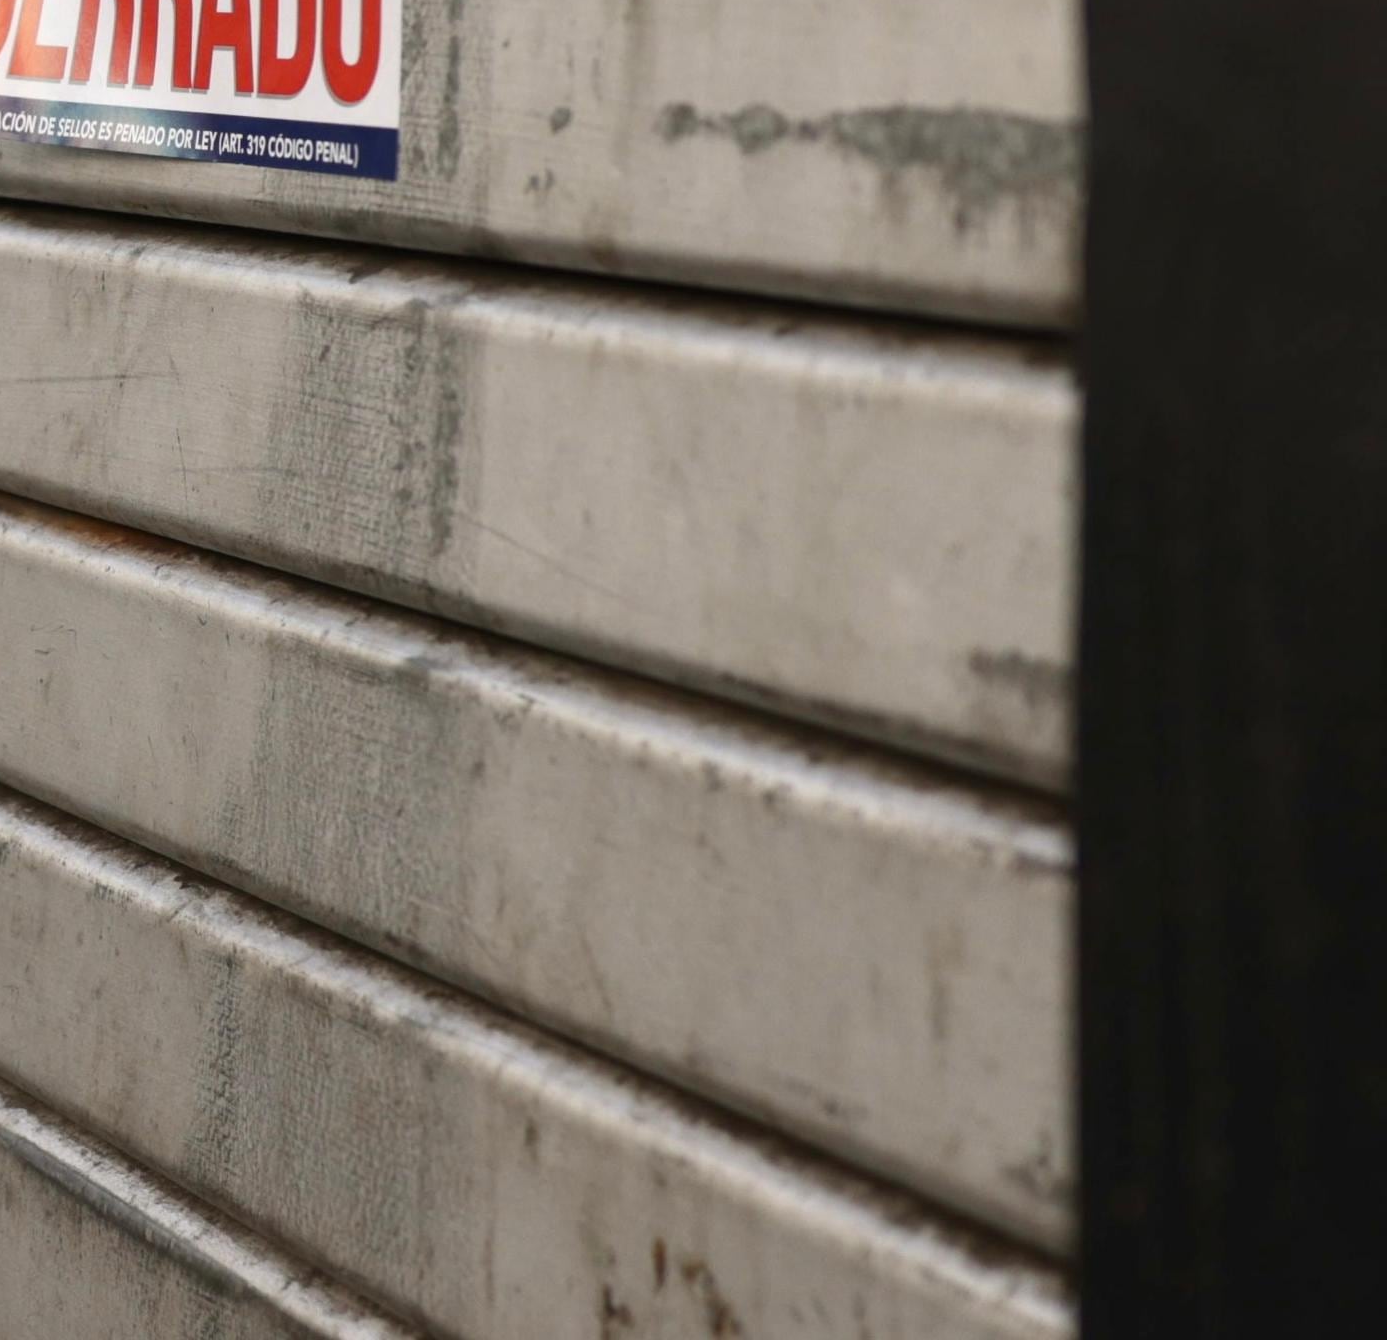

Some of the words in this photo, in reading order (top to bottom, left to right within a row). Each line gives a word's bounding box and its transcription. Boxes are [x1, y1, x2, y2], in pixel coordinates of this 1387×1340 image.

[38, 116, 55, 136] DE
[57, 118, 97, 139] SELLOS
[98, 122, 112, 141] ES
[113, 123, 165, 146] PENADO
[167, 127, 193, 149] POR
[195, 130, 218, 151] LEY
[218, 133, 244, 155] (ART.
[246, 136, 266, 156] 319
[268, 134, 313, 161] CÓDIGO
[315, 141, 359, 169] PENAL)
